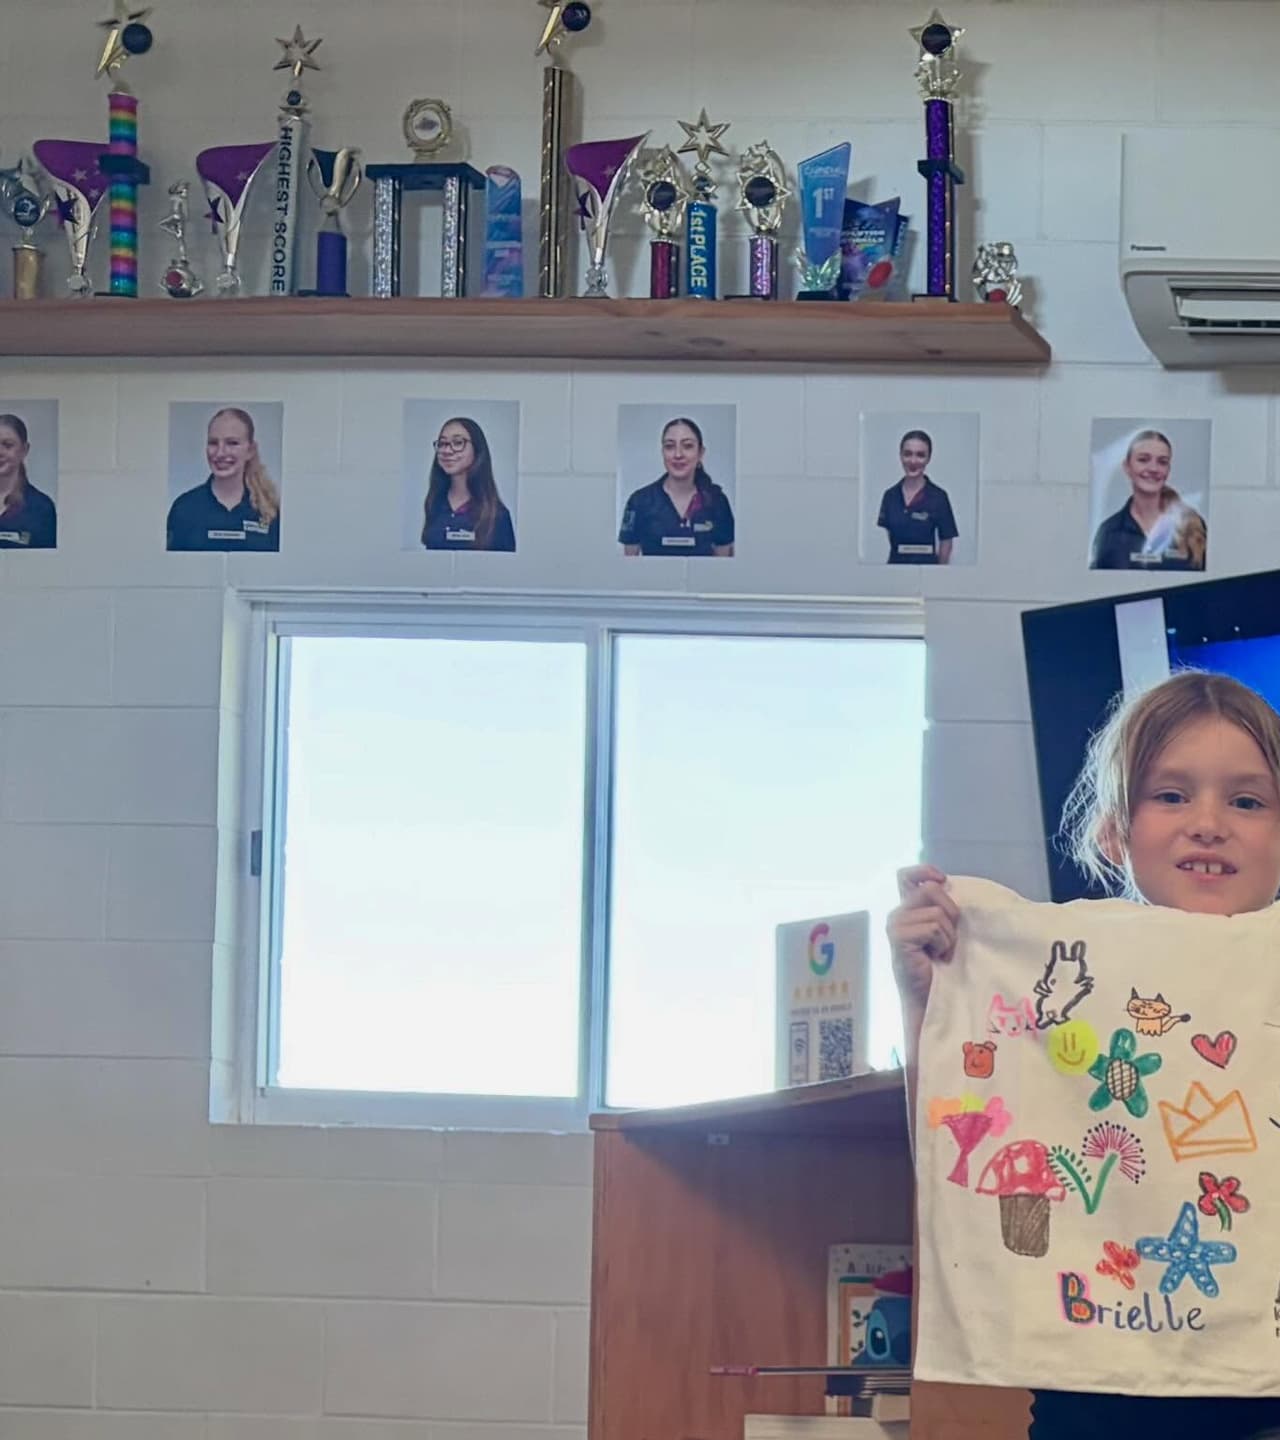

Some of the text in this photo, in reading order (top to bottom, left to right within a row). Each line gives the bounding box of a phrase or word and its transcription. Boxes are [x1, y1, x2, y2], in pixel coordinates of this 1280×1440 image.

[272, 127, 293, 292] HIGHEST SCORE
[812, 187, 835, 218] 1ST
[691, 233, 708, 288] PLACE
[1058, 1271, 1206, 1333] Brielle
